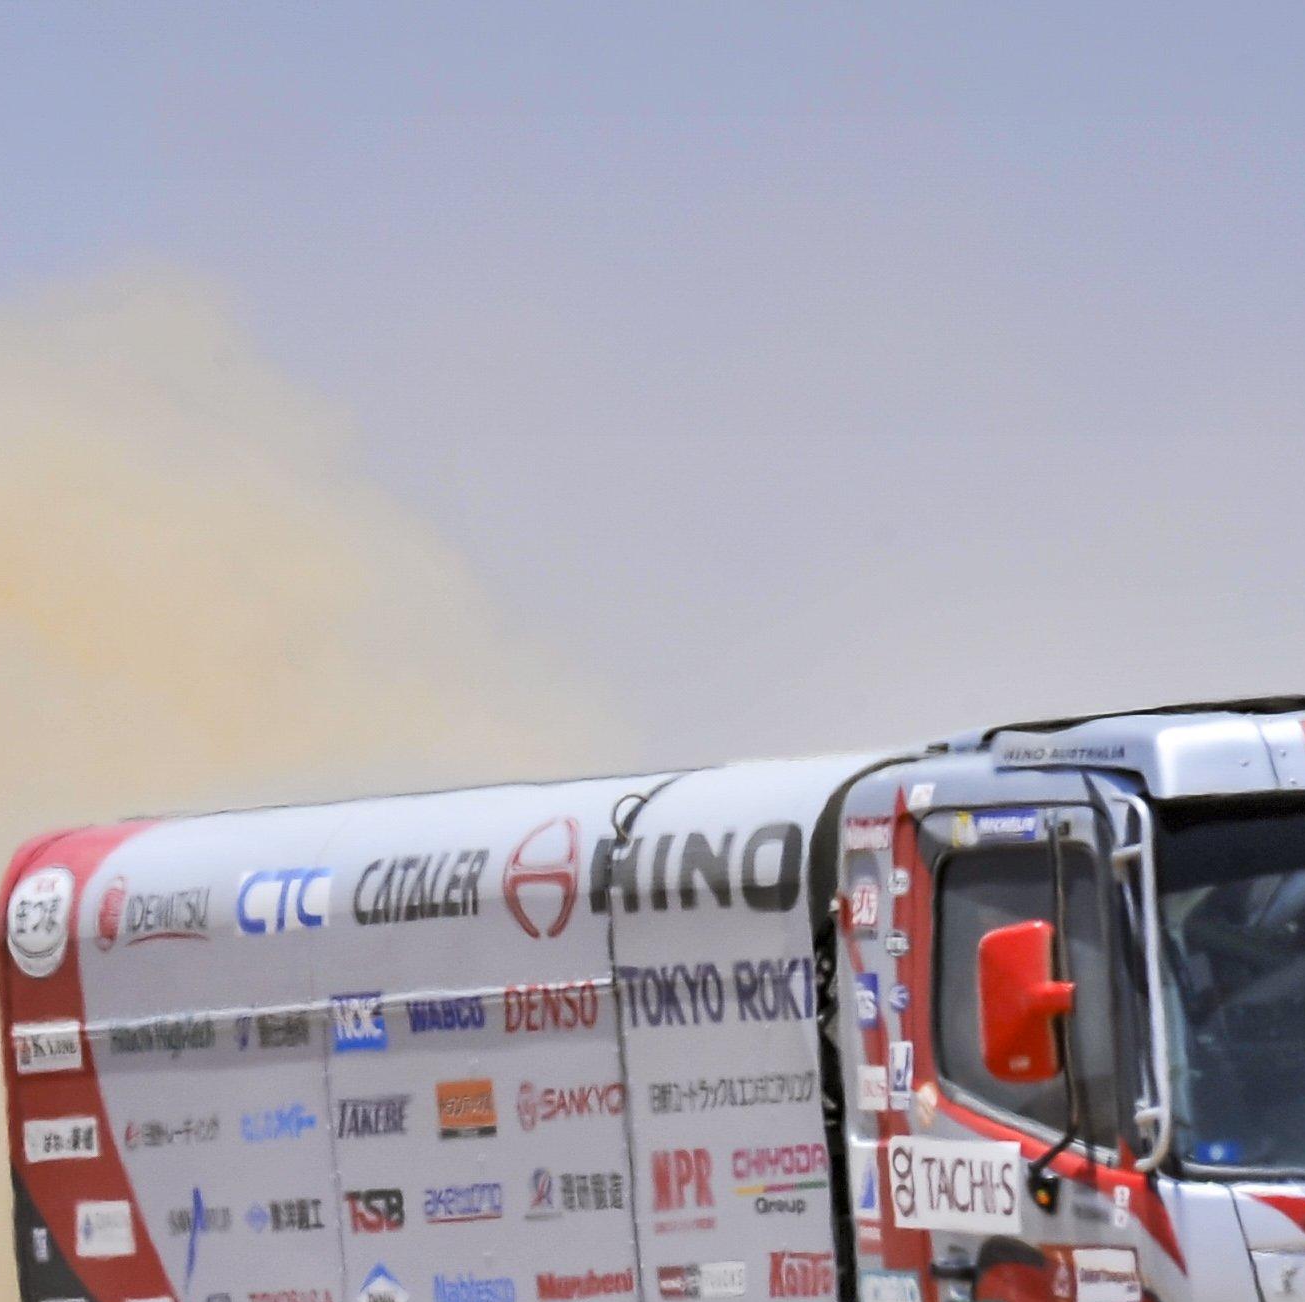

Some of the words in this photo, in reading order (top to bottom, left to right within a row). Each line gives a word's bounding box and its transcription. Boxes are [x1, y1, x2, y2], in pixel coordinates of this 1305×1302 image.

[353, 849, 490, 926] CATALER
[590, 823, 803, 914] HINO
[236, 868, 331, 935] CTC
[407, 996, 486, 1034] WABCO
[503, 981, 599, 1034] DENSO
[617, 963, 724, 1028] TOKYO
[732, 957, 814, 1022] ROKI
[541, 1082, 627, 1122] SANKYO
[731, 1143, 828, 1180] CHIYODA
